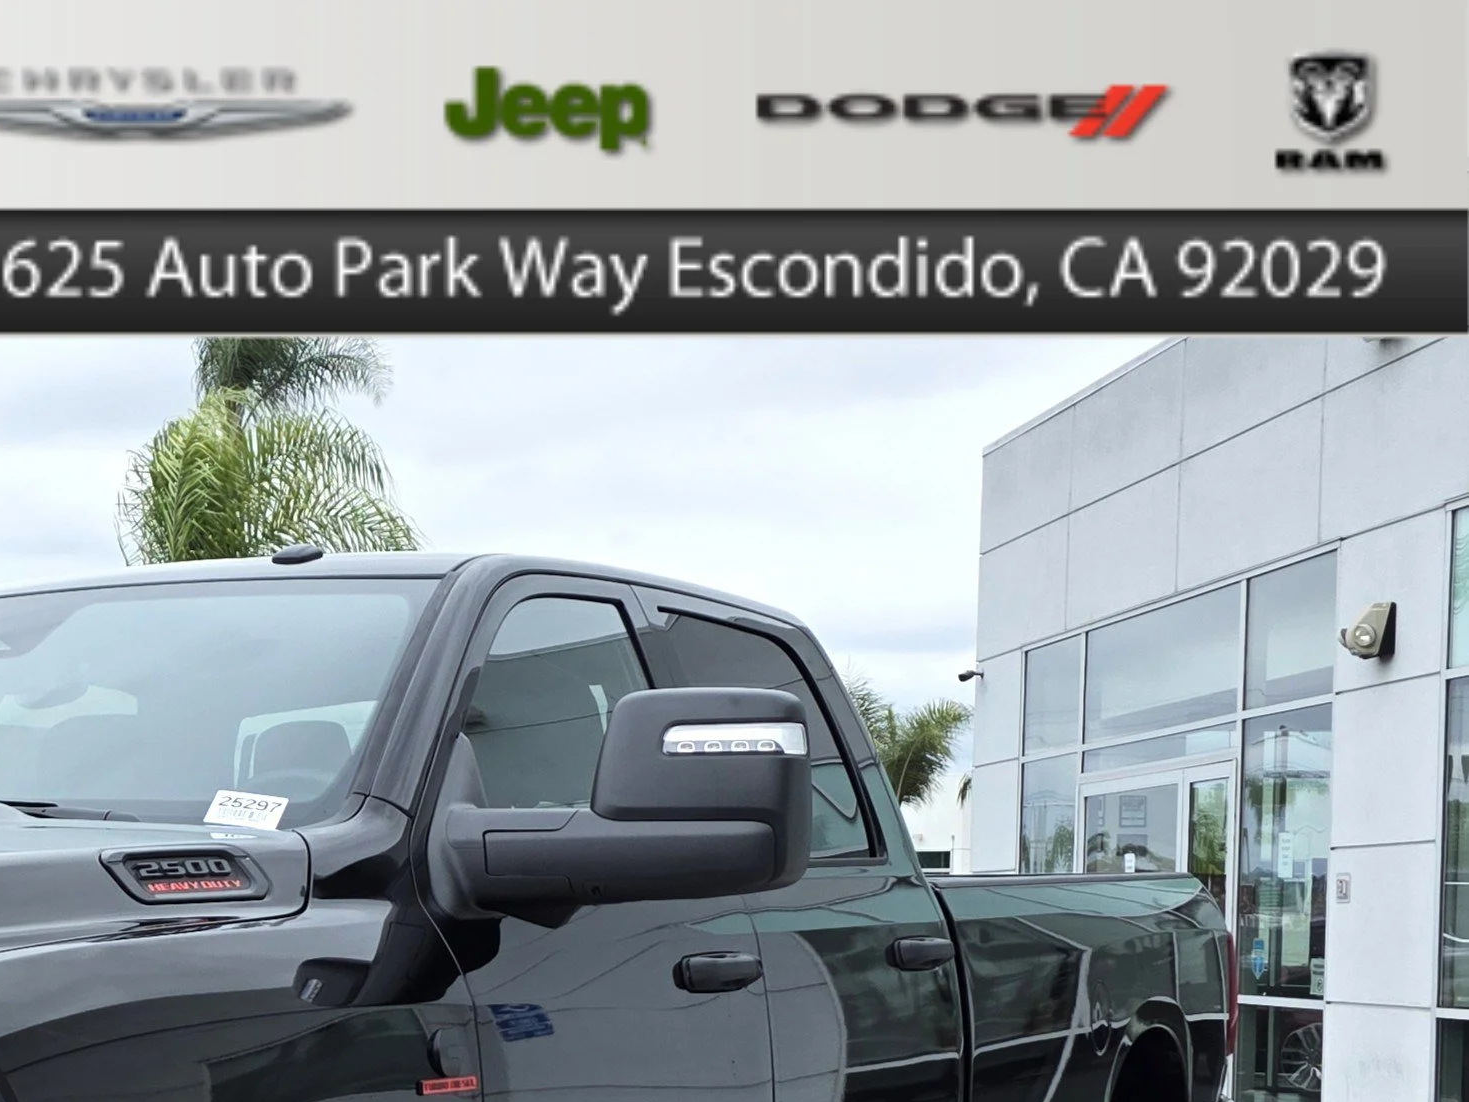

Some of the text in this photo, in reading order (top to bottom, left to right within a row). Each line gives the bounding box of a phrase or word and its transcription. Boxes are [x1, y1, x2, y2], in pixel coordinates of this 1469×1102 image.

[218, 795, 283, 812] 25297
[134, 858, 232, 879] 2500
[147, 878, 241, 893] HEAVY DUTY
